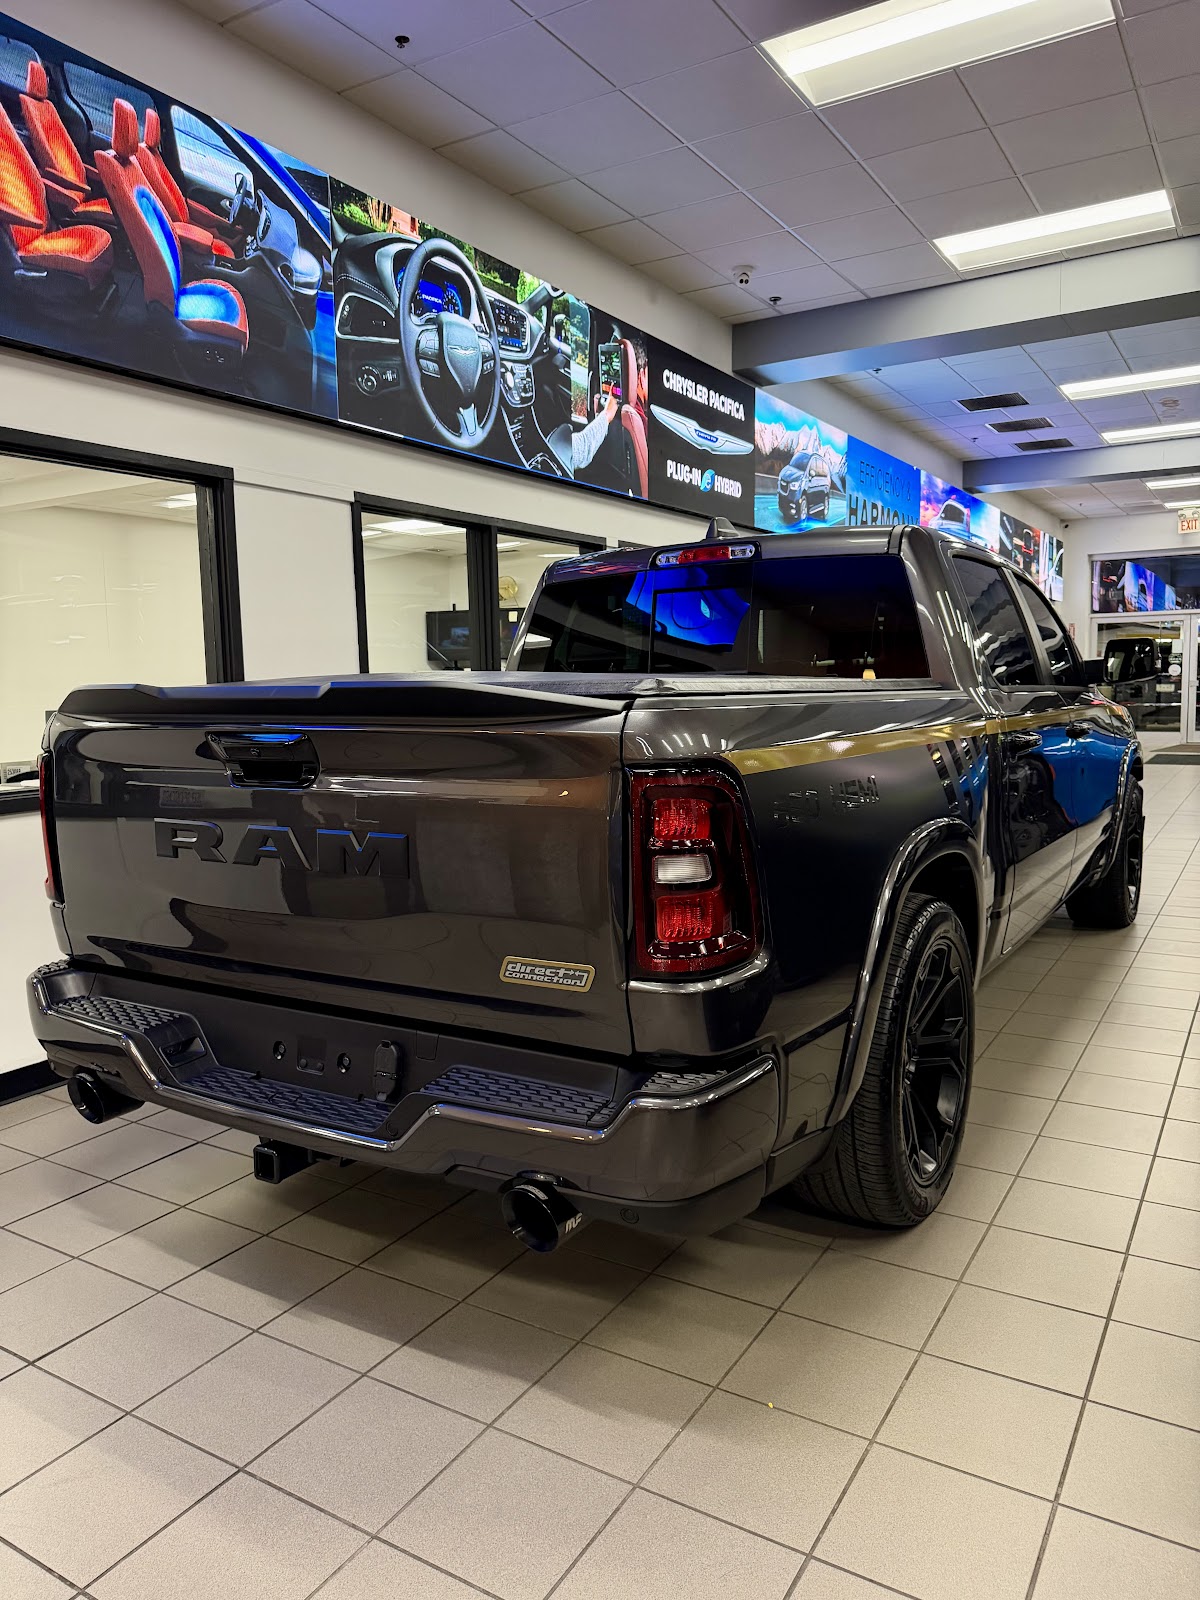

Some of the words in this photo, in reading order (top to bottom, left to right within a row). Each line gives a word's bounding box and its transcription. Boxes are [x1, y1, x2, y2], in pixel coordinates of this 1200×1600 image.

[663, 368, 708, 406] CHRYSLER
[709, 390, 745, 421] PACIFICA
[667, 459, 701, 487] PLUG-IN
[714, 475, 742, 498] HYBRID
[860, 460, 905, 498] EFFICIENCY
[848, 493, 919, 526] HARMO
[1181, 519, 1198, 531] EXIT
[153, 817, 410, 879] RAM
[505, 971, 587, 987] connection
[507, 962, 566, 977] direct
